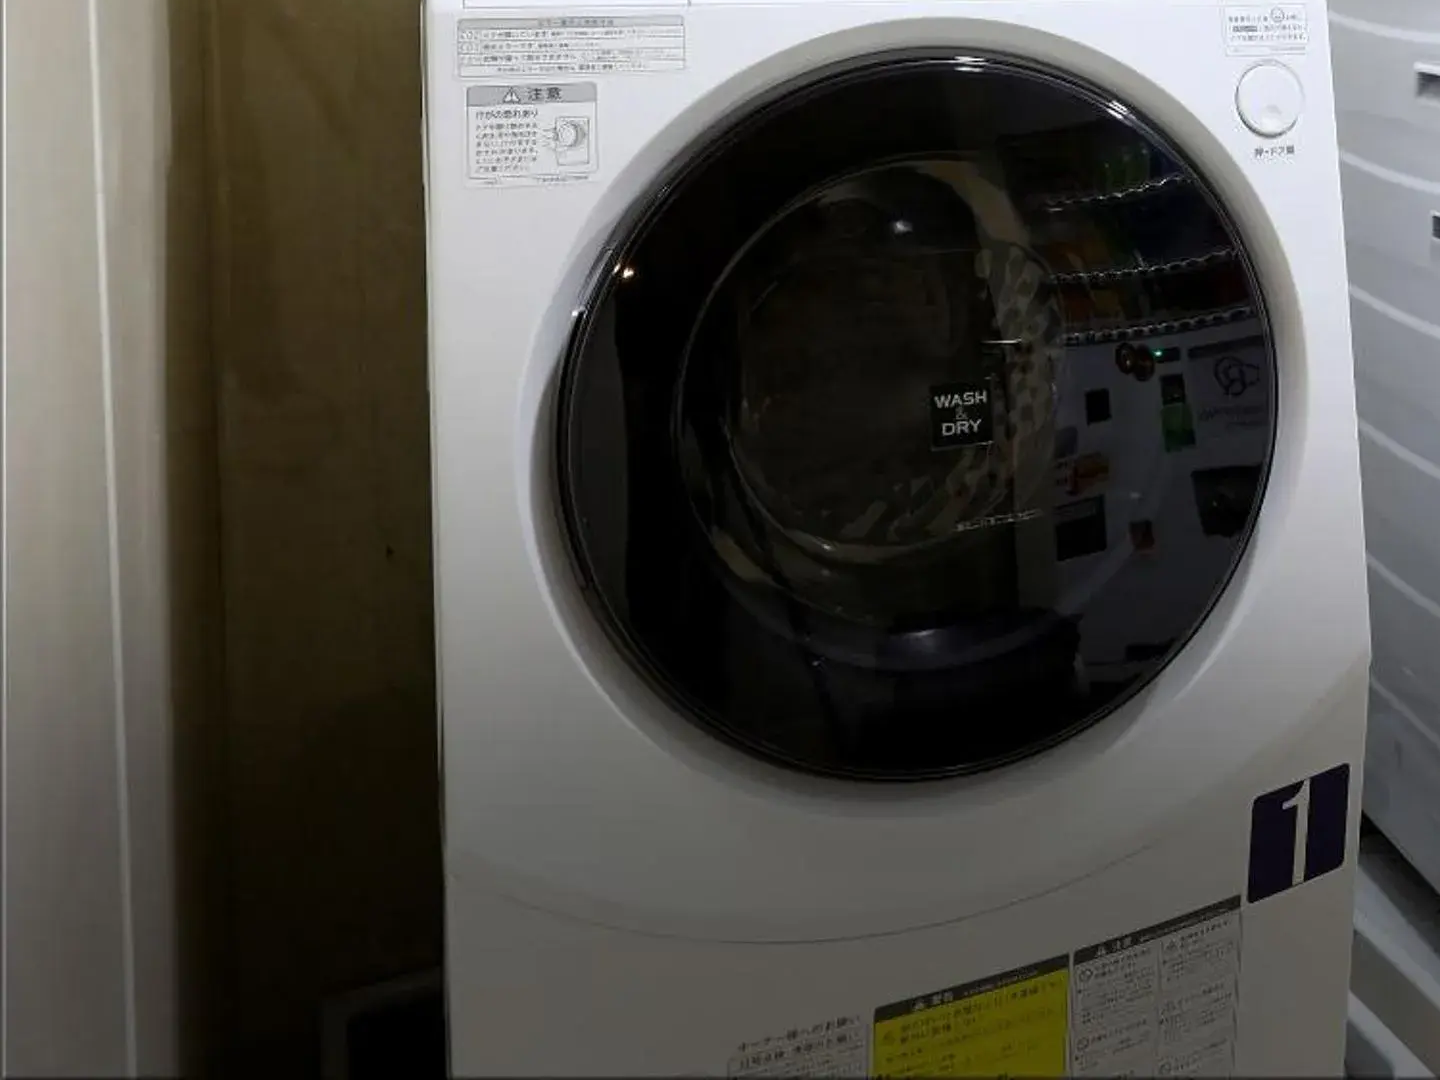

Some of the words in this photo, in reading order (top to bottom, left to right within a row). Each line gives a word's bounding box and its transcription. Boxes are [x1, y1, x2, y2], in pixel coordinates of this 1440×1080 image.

[528, 87, 562, 100] 注意
[934, 390, 987, 408] WASH
[942, 419, 981, 436] DRY
[1282, 778, 1310, 886] 1
